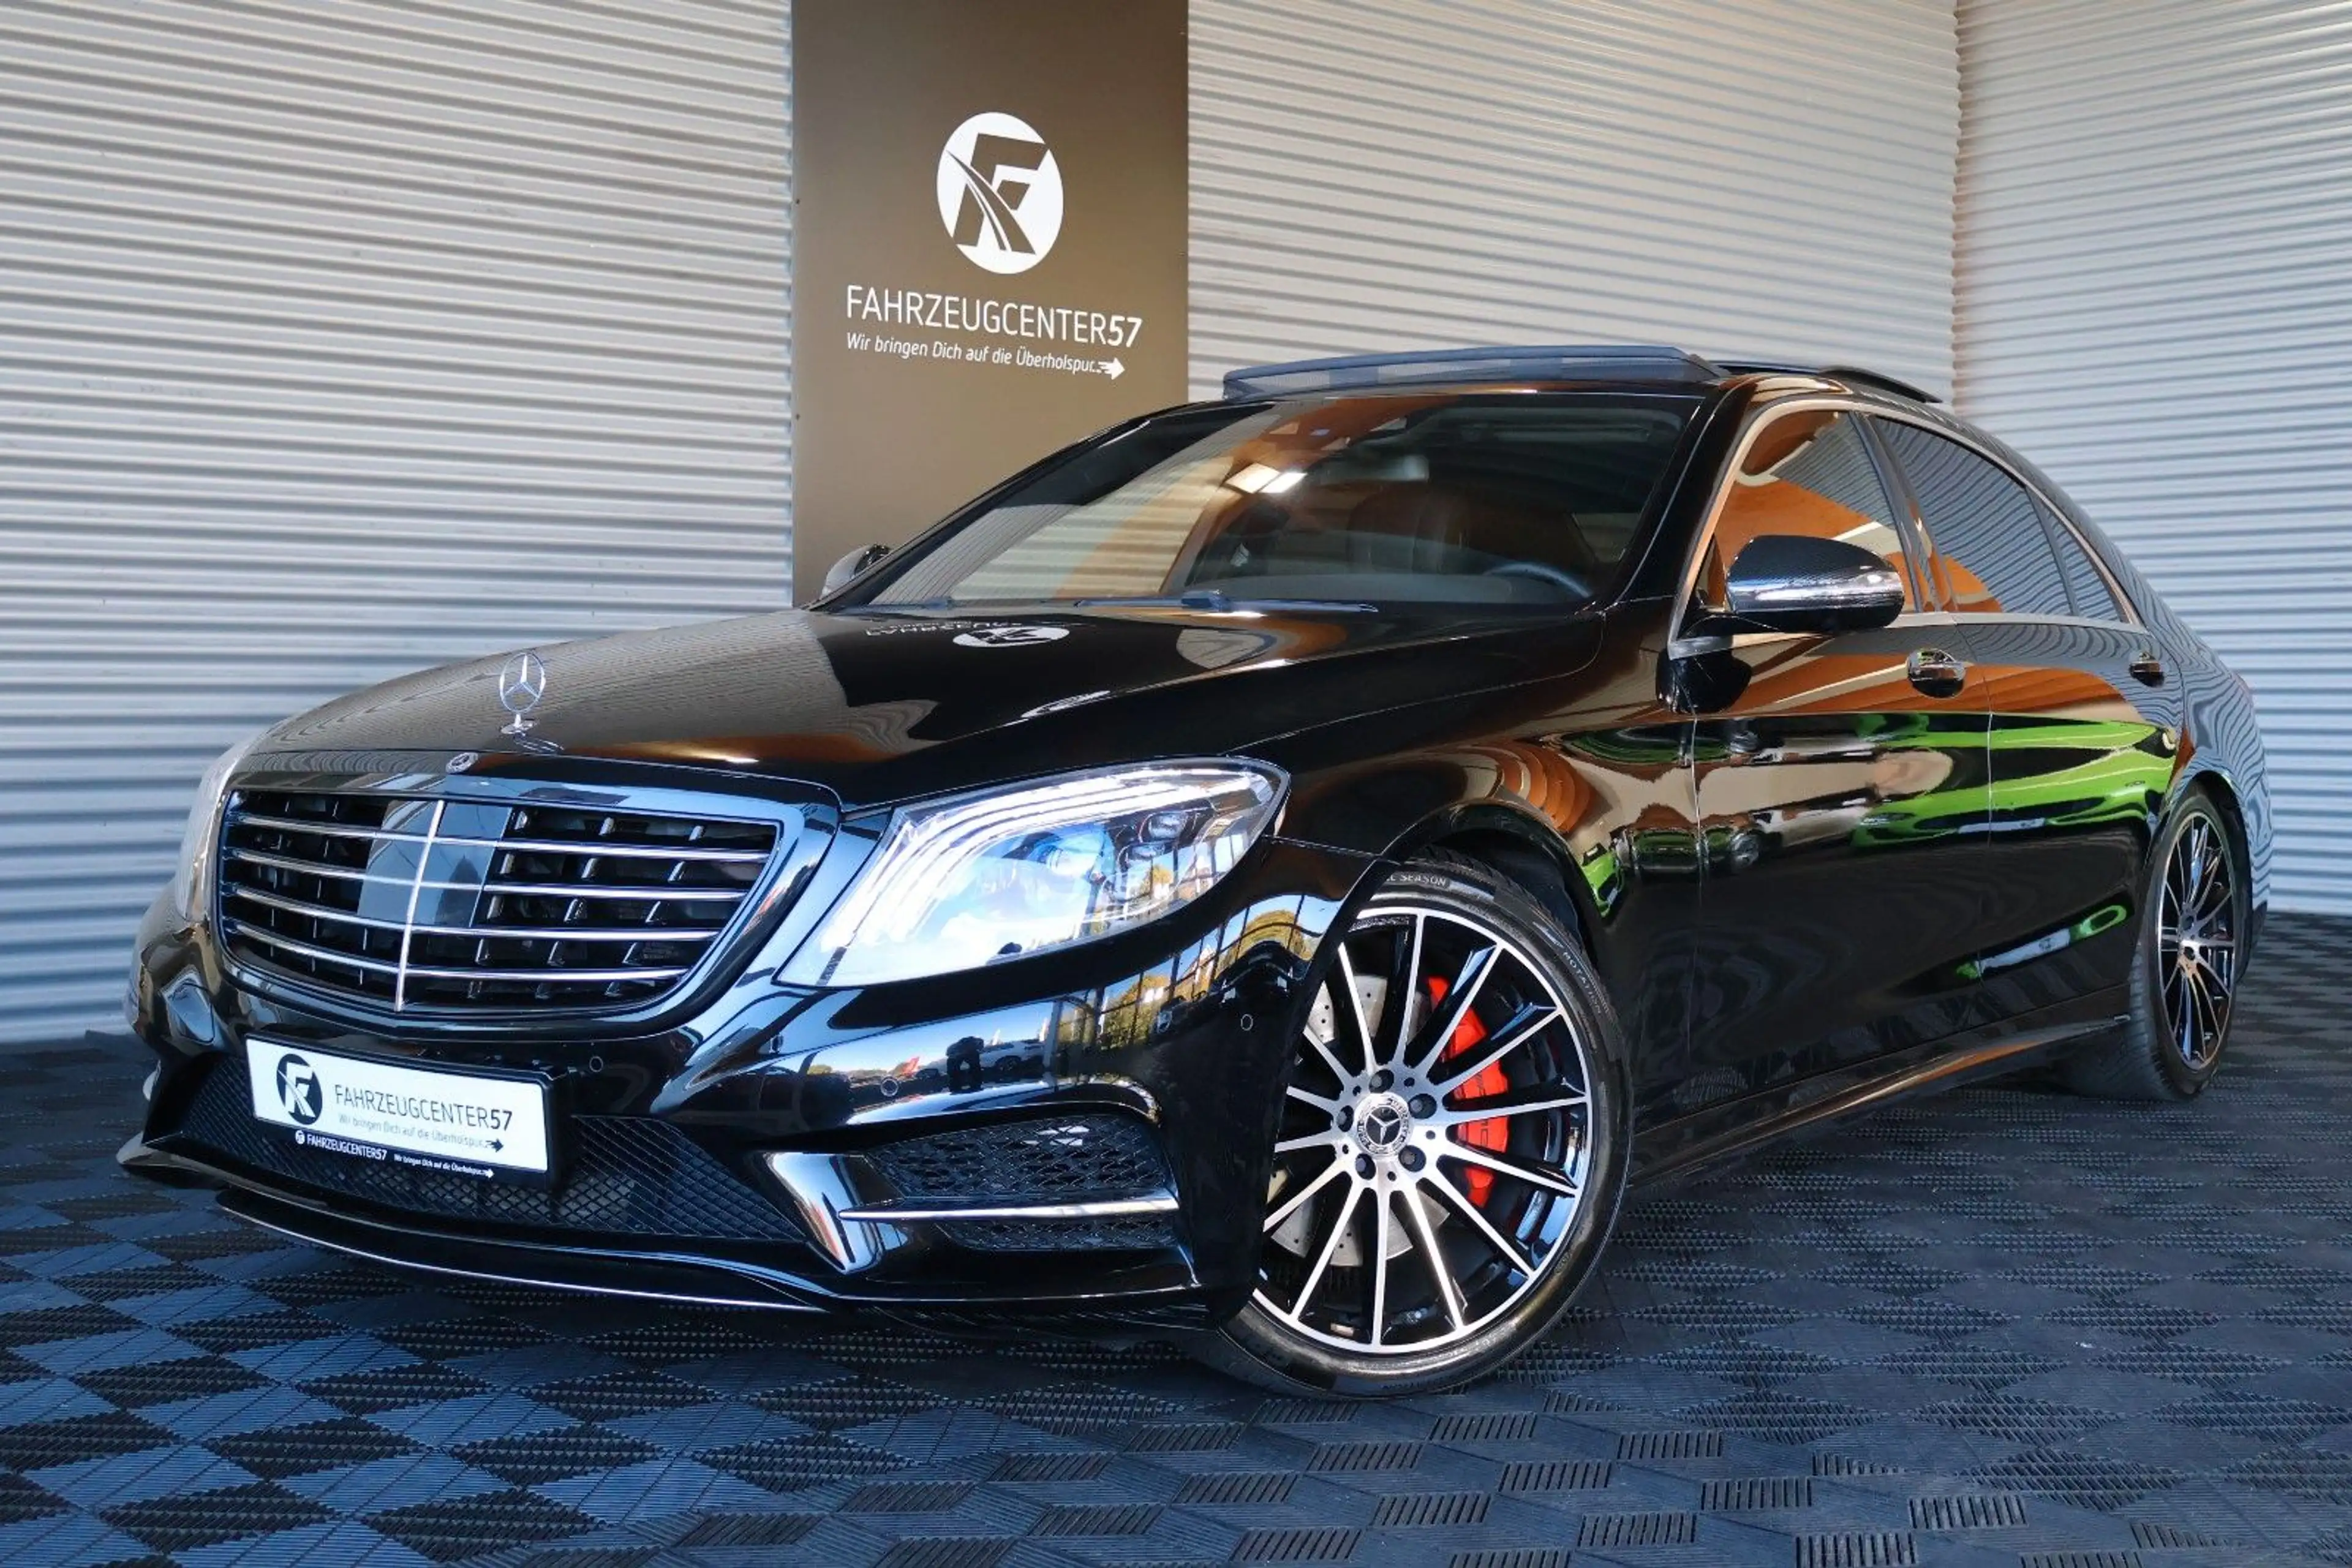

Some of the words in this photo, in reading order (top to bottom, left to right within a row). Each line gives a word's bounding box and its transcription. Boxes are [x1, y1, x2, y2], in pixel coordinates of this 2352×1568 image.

[846, 284, 1143, 349] FAHRZEUGCENTER57
[846, 332, 872, 351] Wir
[874, 334, 929, 360] bringen
[932, 340, 962, 360] Dich
[965, 344, 990, 362] auf
[992, 347, 1012, 364] die
[1400, 873, 1447, 887] SEASON
[334, 1084, 513, 1131] FAHRZEUGCENTER57
[339, 1113, 351, 1124] Wir
[352, 1115, 382, 1132] bringen
[383, 1119, 401, 1134] Dich
[402, 1125, 416, 1136] auf
[417, 1127, 429, 1140] die
[307, 1133, 388, 1161] FAHRZEUGCENTER57
